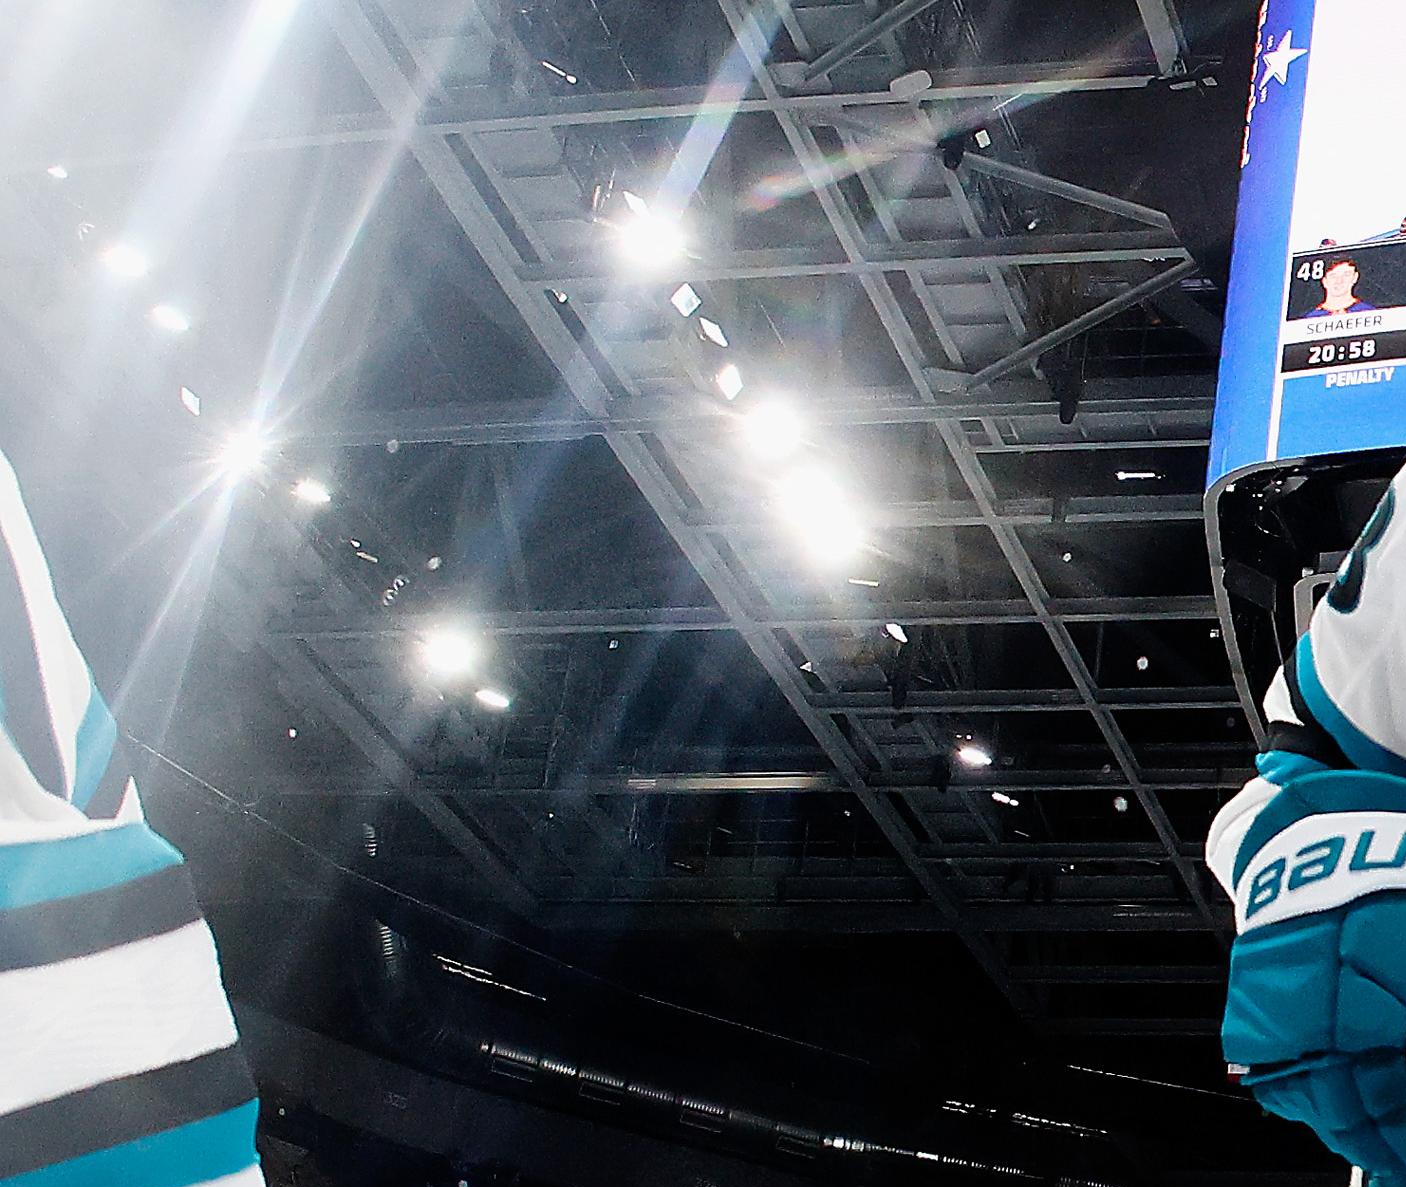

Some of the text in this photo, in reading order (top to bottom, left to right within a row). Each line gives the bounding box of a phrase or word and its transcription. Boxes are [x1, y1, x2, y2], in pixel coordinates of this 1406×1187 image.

[1297, 260, 1325, 281] 48
[1307, 316, 1382, 335] SCHAEFER
[1307, 339, 1376, 364] 20:58
[1325, 367, 1394, 388] PENALTY
